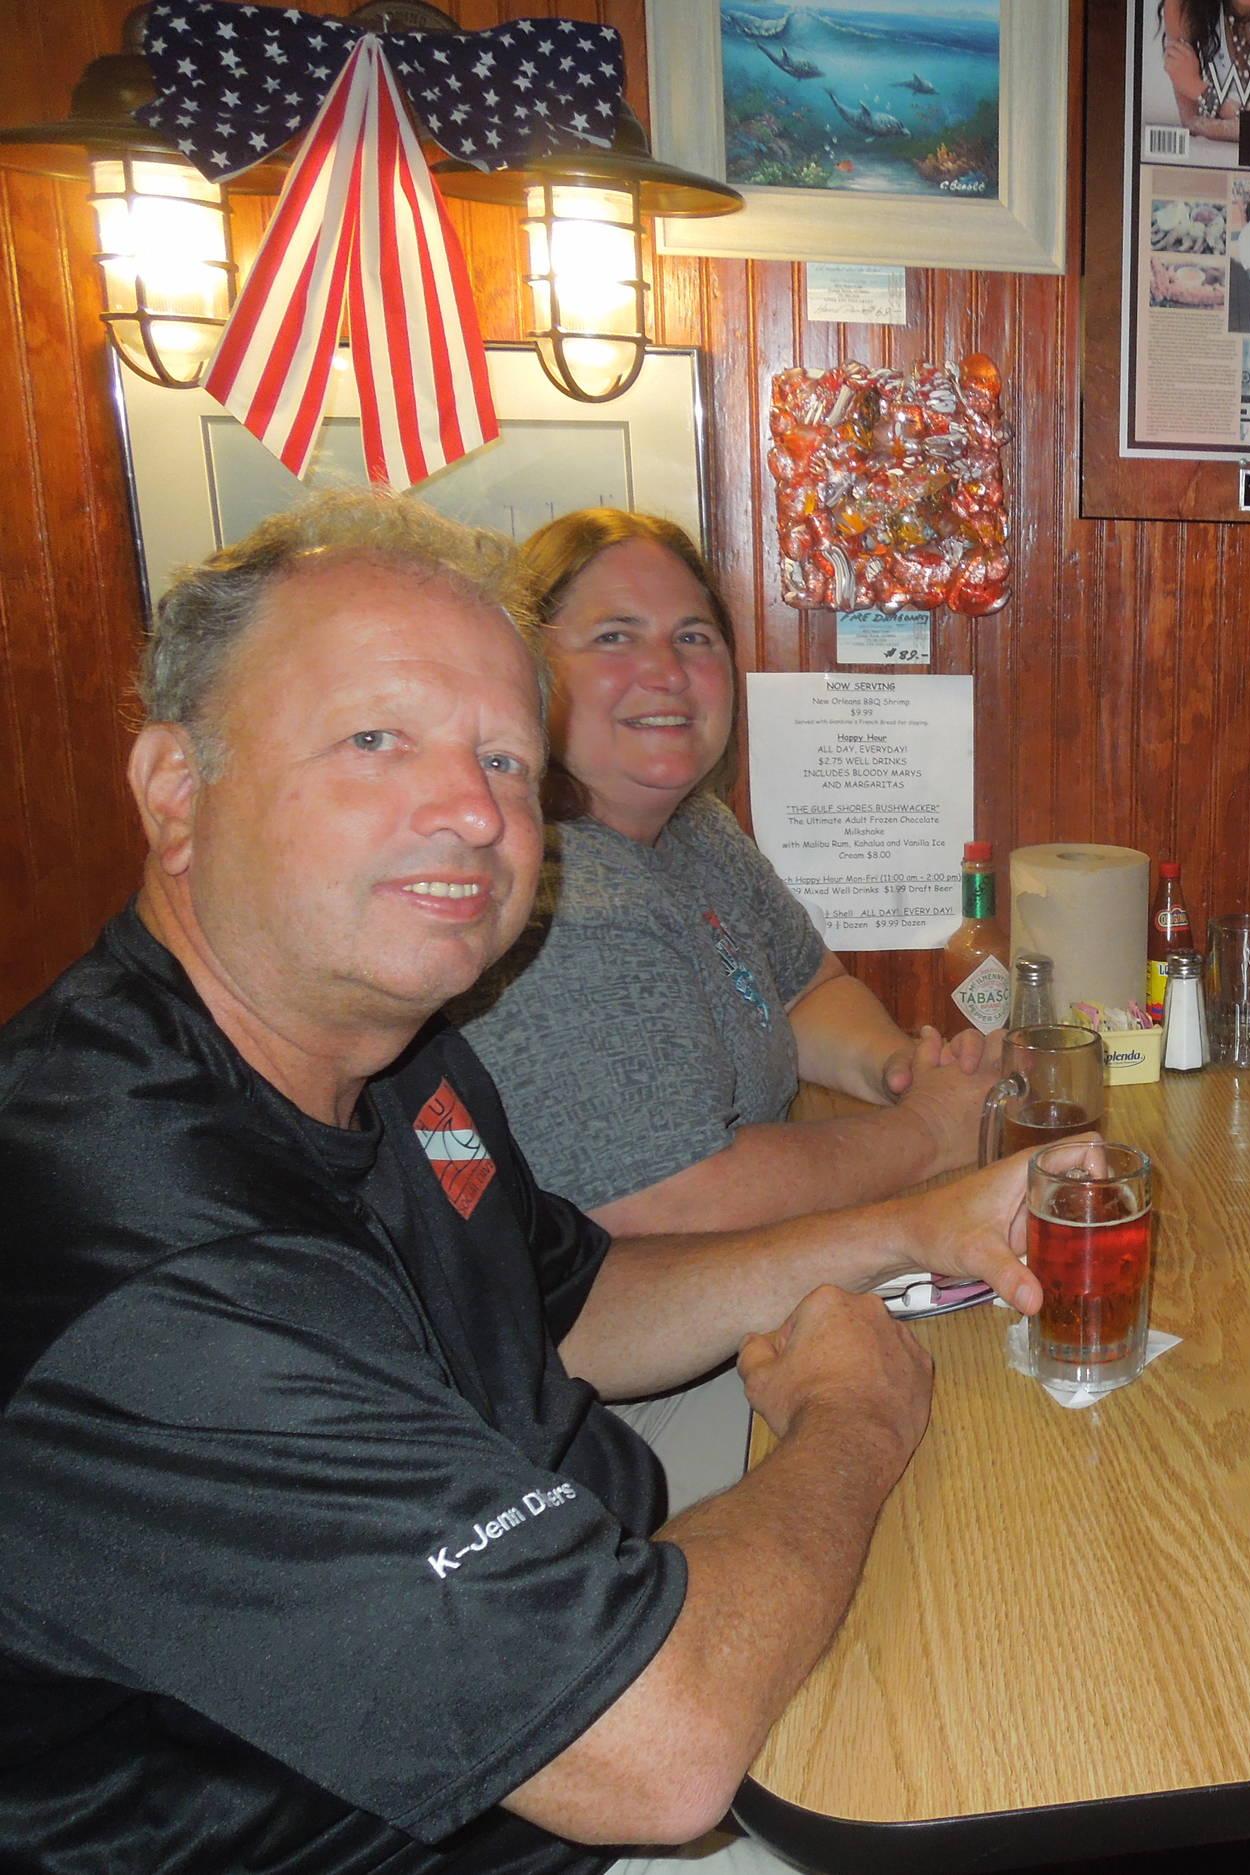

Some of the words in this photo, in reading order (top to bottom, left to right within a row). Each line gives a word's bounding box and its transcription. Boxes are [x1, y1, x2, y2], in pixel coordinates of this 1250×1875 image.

[826, 682, 850, 691] NOW
[854, 682, 896, 691] SERVING
[812, 697, 829, 705] New
[863, 697, 881, 706] BBQ
[883, 697, 910, 706] Shrimp
[837, 733, 863, 743] Happy
[867, 733, 887, 742] Hour
[860, 745, 908, 753] EVERYDAY!
[818, 757, 843, 765] $2.75
[845, 757, 869, 765] WELL
[872, 757, 908, 765] DRINKS
[803, 769, 850, 777] INCLUDES
[853, 769, 888, 777] BLOODY
[891, 769, 922, 777] MARYS
[822, 781, 841, 789] AND
[844, 781, 905, 789] MARGARITAS
[811, 804, 833, 813] GULF
[836, 804, 873, 813] SHORES
[788, 817, 803, 825] The
[806, 817, 842, 825] Ultimate
[845, 816, 867, 824] Adult
[869, 816, 897, 824] Frozen
[900, 816, 939, 824] Chocolate
[782, 841, 800, 849] with
[802, 840, 830, 848] Malibu
[886, 839, 900, 847] and
[903, 839, 930, 847] Vanilla
[932, 839, 945, 847] Ice
[867, 851, 891, 859] $8.00
[795, 876, 820, 885] Happy
[823, 875, 843, 883] Hour
[804, 887, 829, 895] Mixed
[832, 886, 851, 894] Well
[852, 886, 879, 894] Drinks
[884, 885, 906, 894] $1.99
[909, 885, 932, 893] Draft
[934, 884, 953, 892] Beer
[833, 910, 853, 918] Shell
[861, 909, 877, 917] ALL
[904, 908, 931, 916] EVERY
[843, 921, 868, 929] Dozen
[876, 920, 898, 928] $9.99
[901, 919, 926, 927] Dozen
[960, 988, 1009, 1004] TABASC
